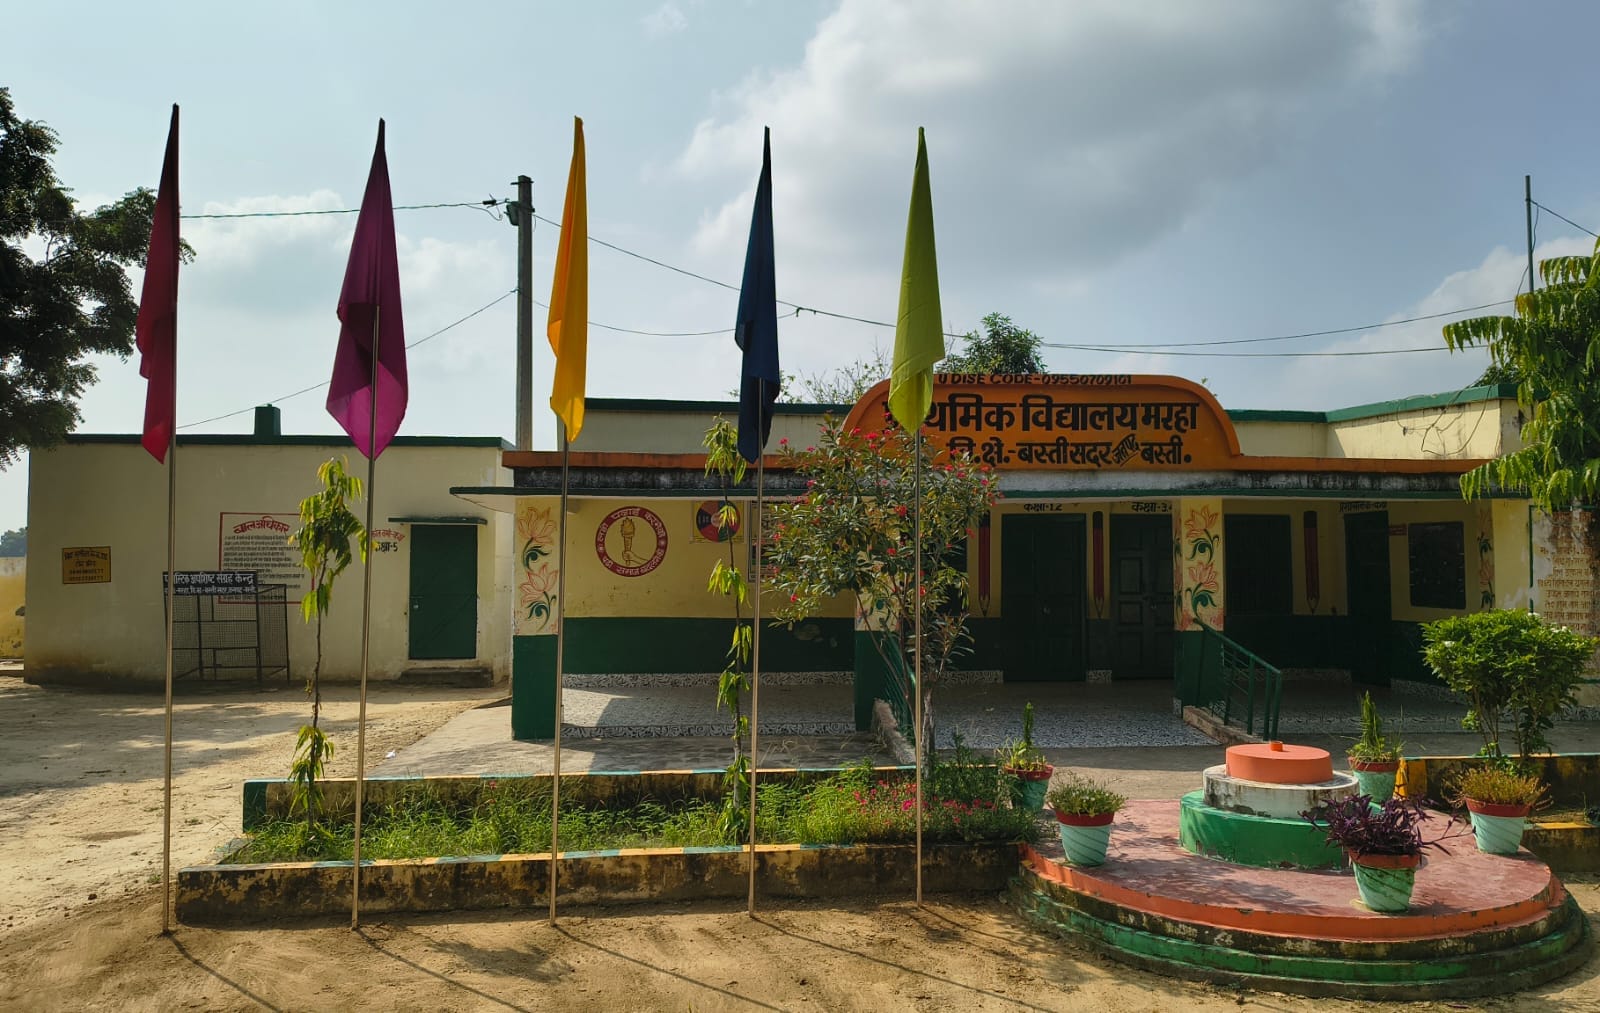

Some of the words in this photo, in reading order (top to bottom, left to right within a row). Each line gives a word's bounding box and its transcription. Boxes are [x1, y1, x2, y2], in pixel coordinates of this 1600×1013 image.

[951, 374, 985, 384] DISE
[1019, 394, 1139, 431] विद्यालय
[1141, 402, 1199, 433] मरहा
